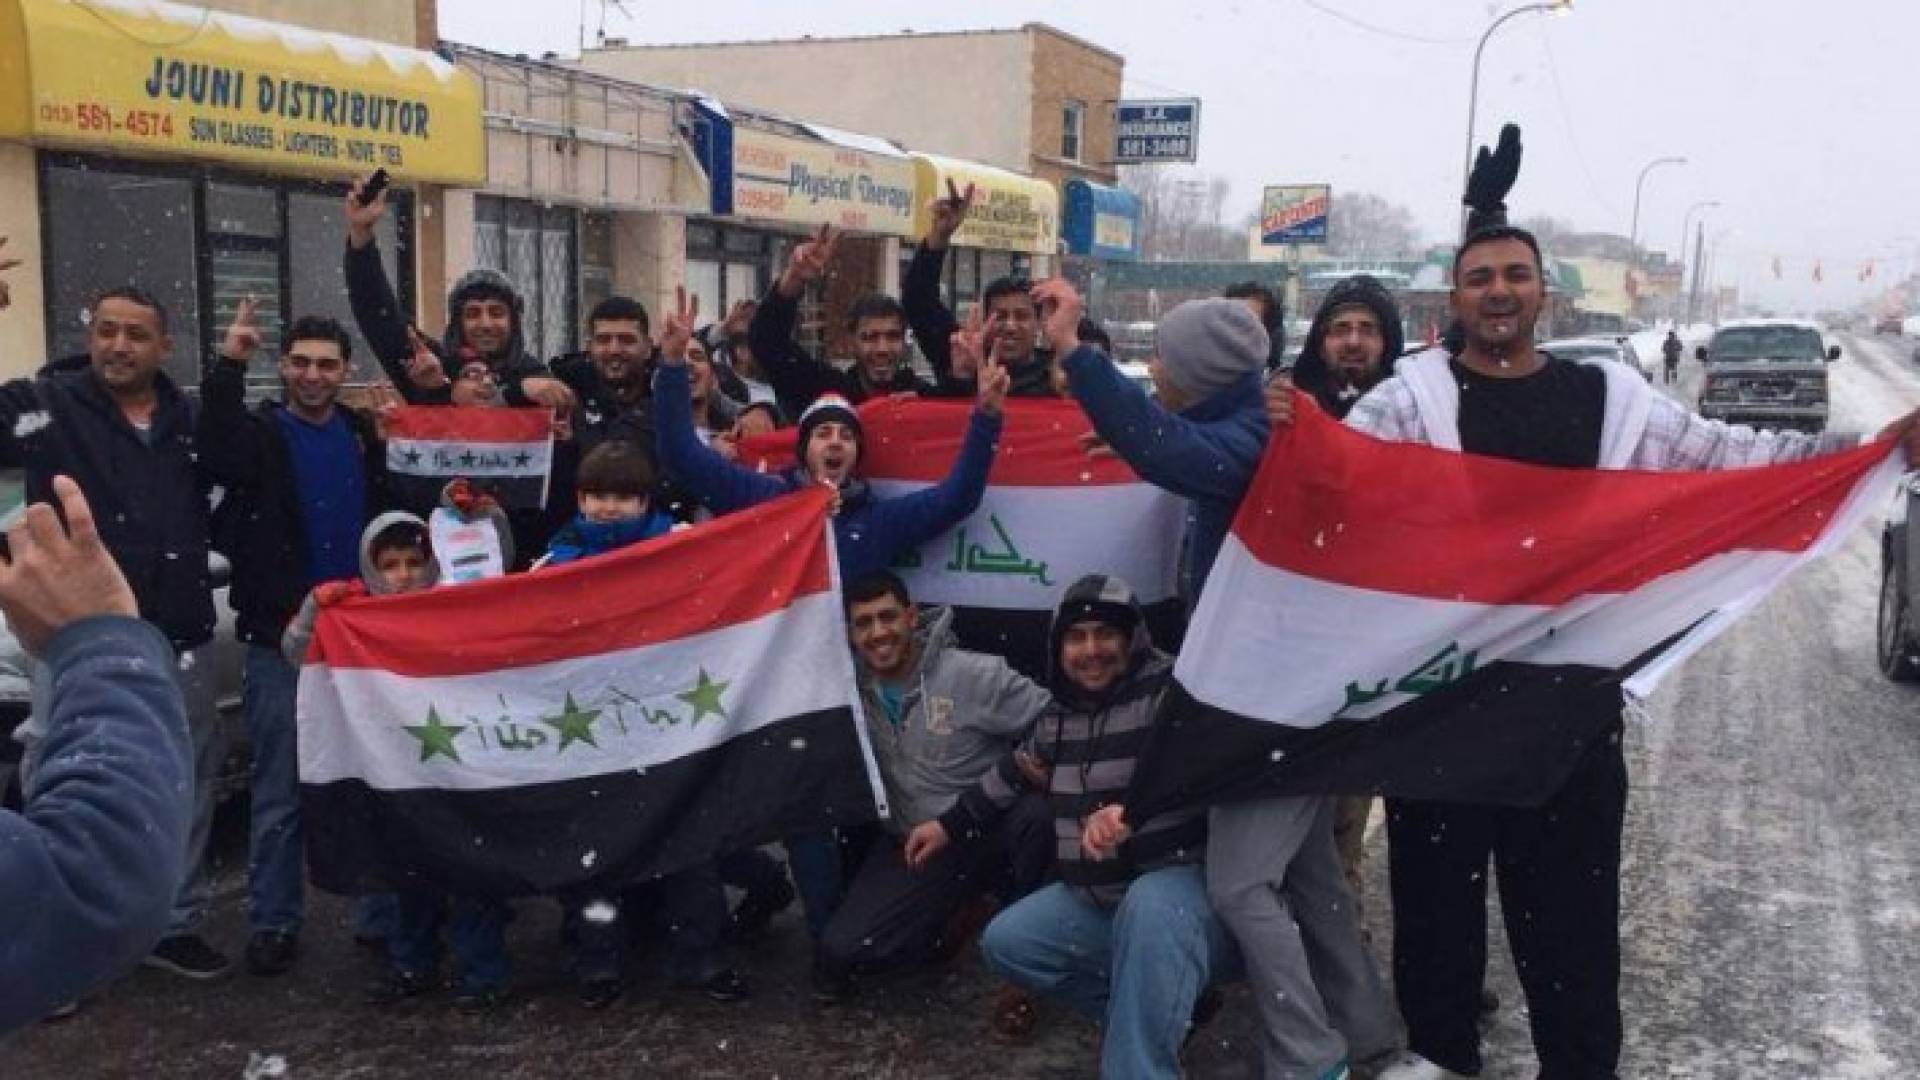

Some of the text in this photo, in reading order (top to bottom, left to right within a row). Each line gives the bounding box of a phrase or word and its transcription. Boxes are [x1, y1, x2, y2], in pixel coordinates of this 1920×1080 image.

[145, 56, 429, 140] JOUNI DISTRIBUTOR
[189, 117, 217, 143] SUN
[220, 121, 274, 149] GLASSES
[788, 162, 853, 205] Physical
[858, 174, 913, 217] Therapy
